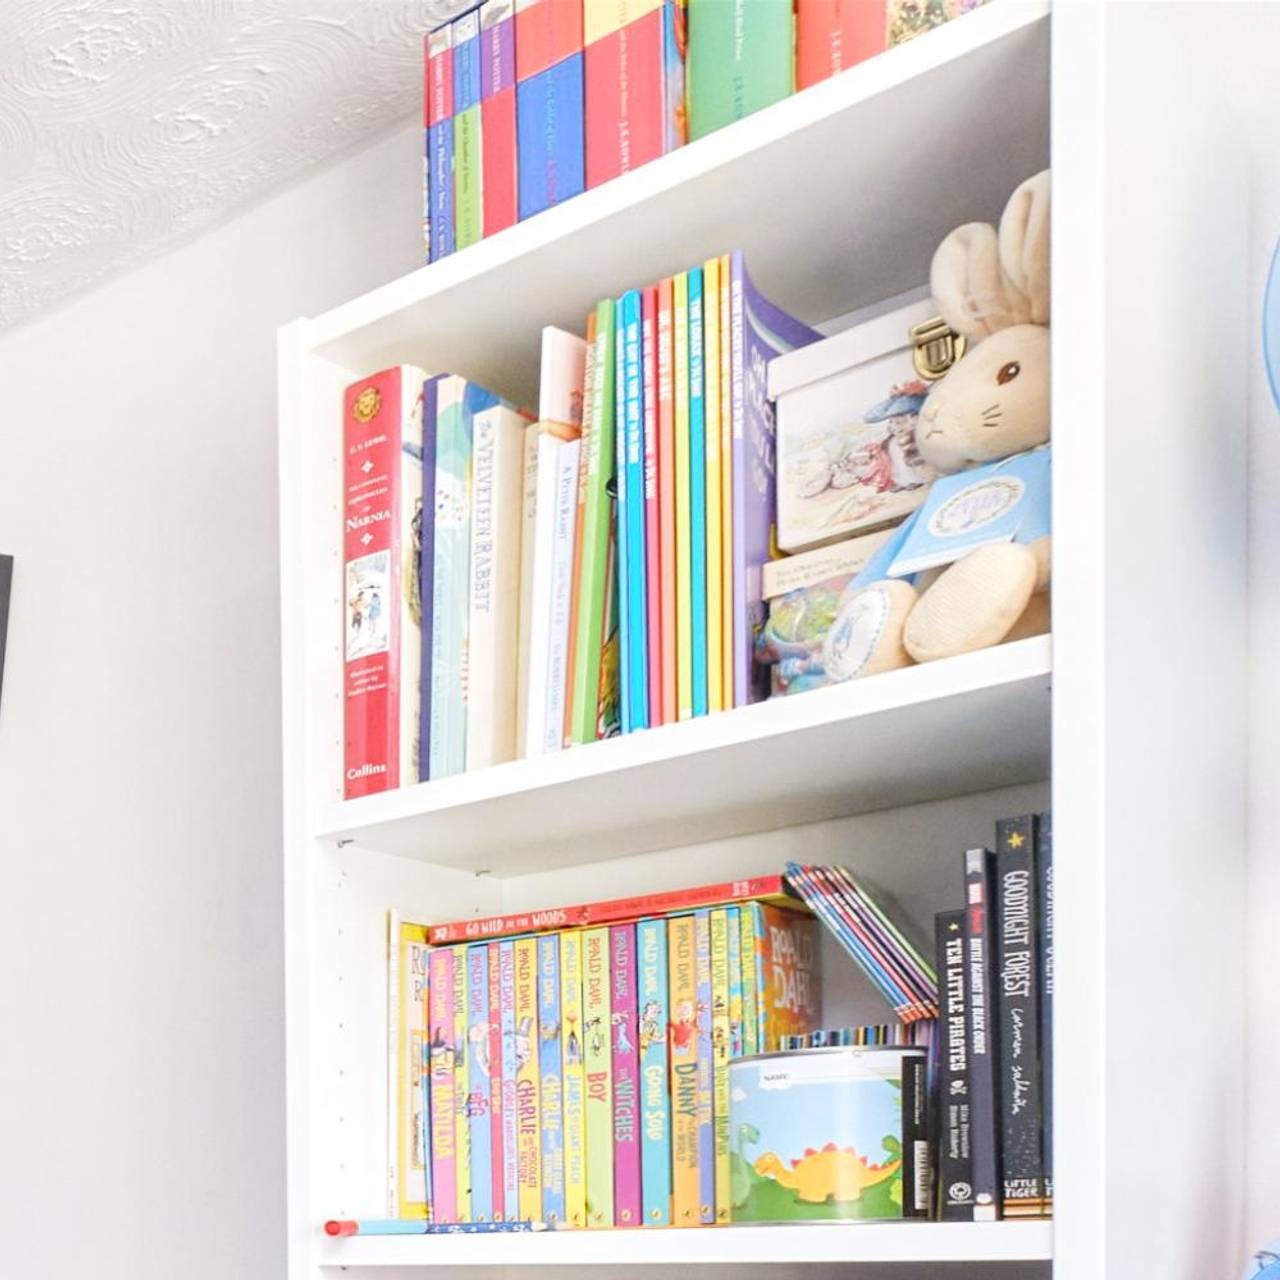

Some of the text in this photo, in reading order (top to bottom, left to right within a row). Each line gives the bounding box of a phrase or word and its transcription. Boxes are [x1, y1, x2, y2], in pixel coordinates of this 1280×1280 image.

[476, 439, 492, 537] VELVETEEN
[345, 510, 392, 534] NARNIA
[474, 540, 492, 613] RABBIT
[346, 763, 386, 780] Collins
[465, 911, 567, 937] GO WILD WOODS
[771, 923, 813, 966] ROALD
[1002, 870, 1030, 998] GOODNIGHT FOREST
[472, 953, 483, 1016] ROALD DAHL
[503, 950, 513, 1013] ROALD DAHL
[519, 948, 530, 1012] ROALD DAHL
[588, 937, 602, 1008] ROALD DAHL
[615, 932, 628, 1000] ROALD DAHL
[645, 927, 658, 996] ROALD DAHL
[945, 938, 964, 1071] TEN LITTLE PIRATES
[969, 938, 986, 1054] BATTLE AGAINST THE BLACK ORDER
[1010, 1008, 1024, 1058] carmen
[469, 1092, 488, 1116] BFG
[517, 1079, 536, 1135] CHARLIE
[543, 1074, 560, 1130] CHARLIE
[568, 1074, 580, 1117] JAMES
[587, 1072, 608, 1102] BOY
[615, 1079, 634, 1141] WITCHES
[645, 1065, 665, 1140] GOING SOLO
[675, 1063, 698, 1118] DANNY
[435, 1085, 453, 1159] MATILDA
[688, 1126, 697, 1168] CHAMPION
[519, 1152, 528, 1184] FACTORY
[528, 1147, 538, 1188] CHOCOLATE
[1004, 1178, 1037, 1188] LITTLE
[1004, 1189, 1037, 1199] TIGER
